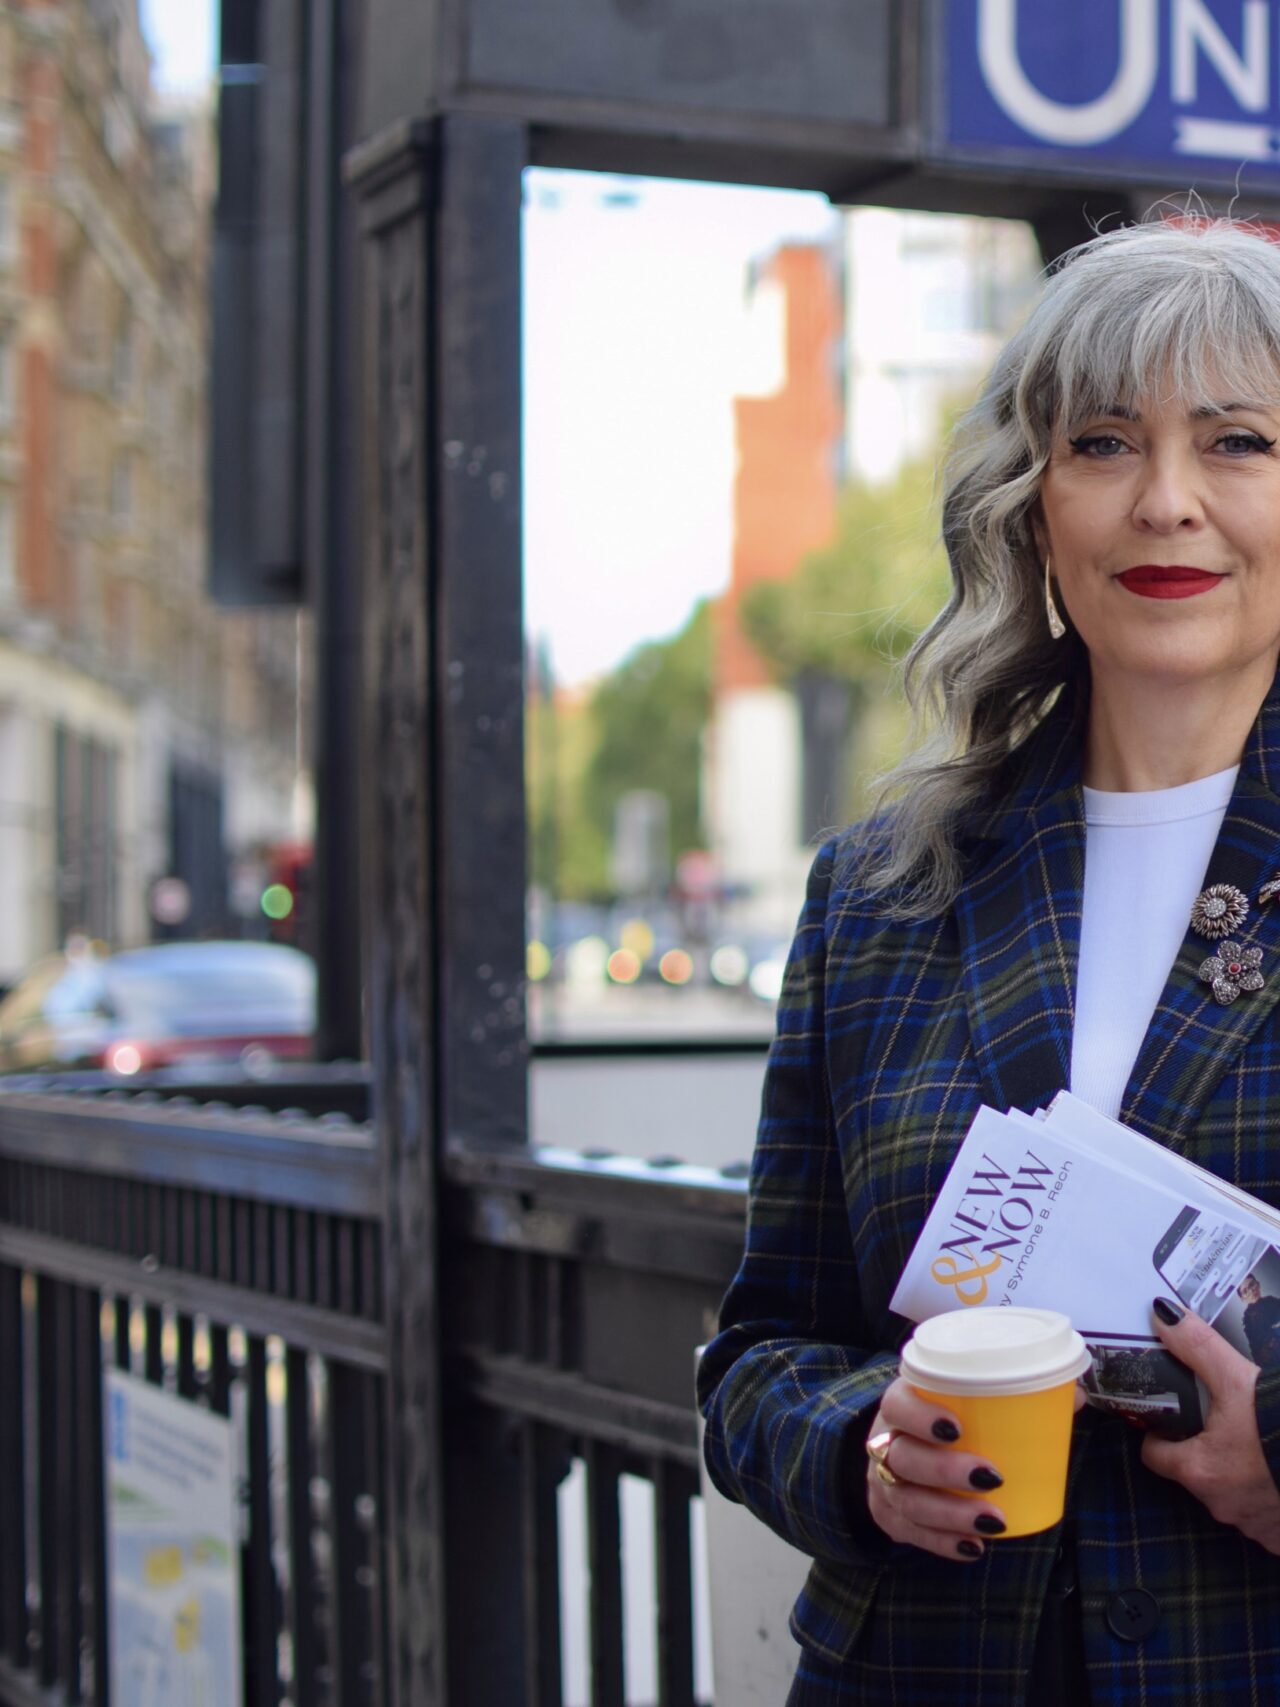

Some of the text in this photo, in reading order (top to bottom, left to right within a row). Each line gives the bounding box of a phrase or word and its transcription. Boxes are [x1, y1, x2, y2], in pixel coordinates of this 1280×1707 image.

[939, 1153, 1011, 1261] NEW
[980, 1150, 1054, 1263] NOW
[1007, 1224, 1044, 1290] Symone
[1040, 1207, 1053, 1220] B.
[1048, 1160, 1073, 1201] Rech
[930, 1244, 1002, 1305] &
